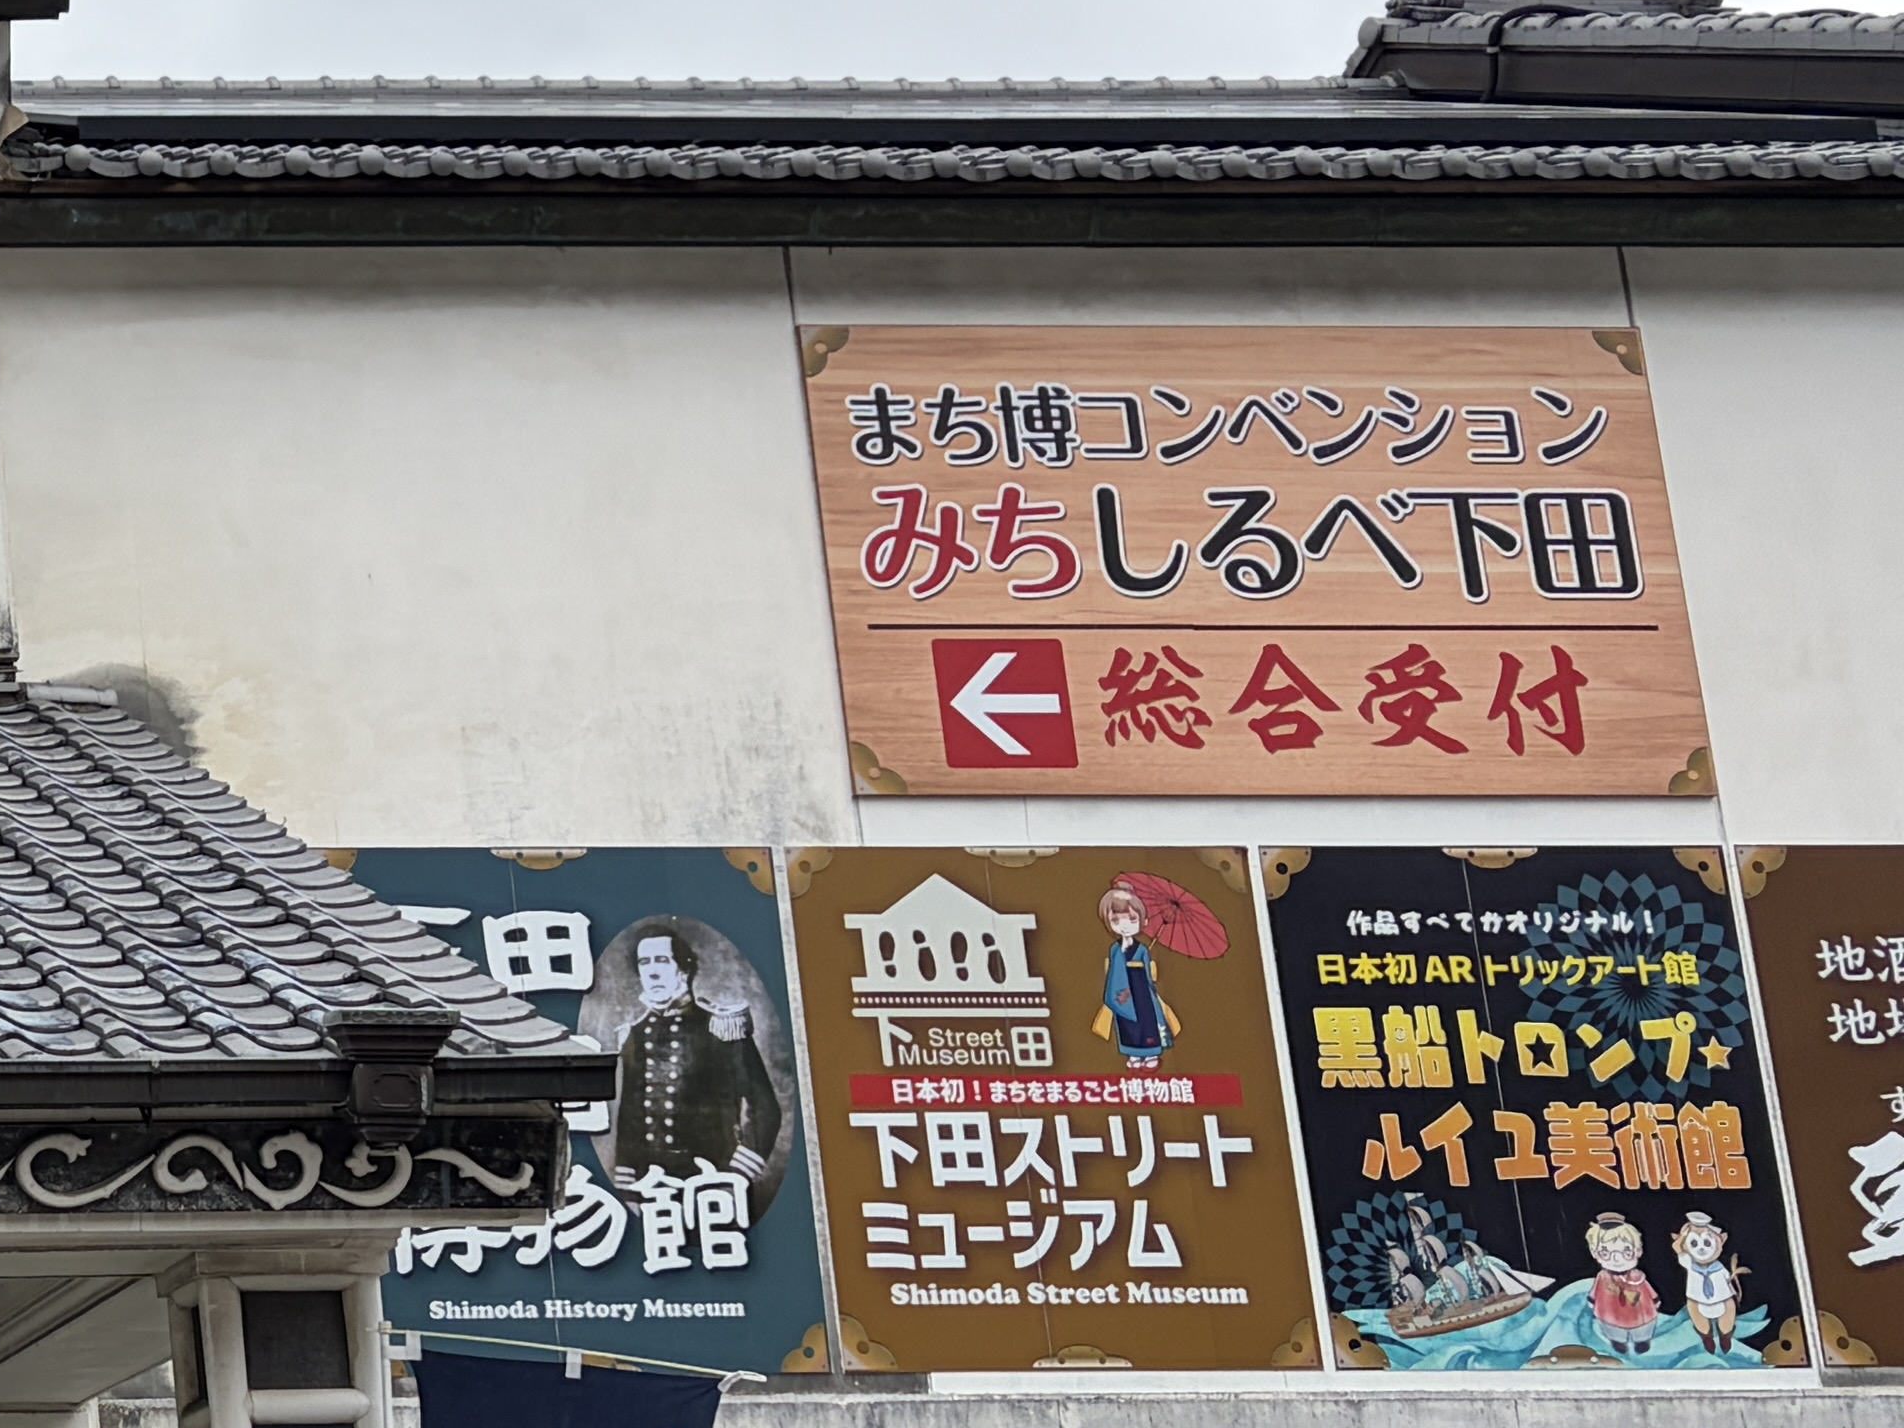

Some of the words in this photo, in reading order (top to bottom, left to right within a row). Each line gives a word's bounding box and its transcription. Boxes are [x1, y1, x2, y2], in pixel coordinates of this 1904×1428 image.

[845, 383, 1608, 468] まち博コンベンション
[861, 483, 1645, 604] みちしるべ下田
[1097, 641, 1590, 757] 総合受付
[898, 1045, 1010, 1067] Museum
[928, 1027, 1004, 1048] Street
[849, 1111, 1254, 1188] 下田ストリート
[1362, 1101, 1752, 1190] ルイユ美術館
[862, 1189, 1183, 1271] ミュージアム
[429, 1300, 539, 1320] Shimoda
[544, 1299, 637, 1322] History
[644, 1298, 746, 1318] Museum
[890, 1283, 1020, 1306] Shimoda
[1027, 1283, 1120, 1305] Street
[1126, 1283, 1249, 1305] Museum
